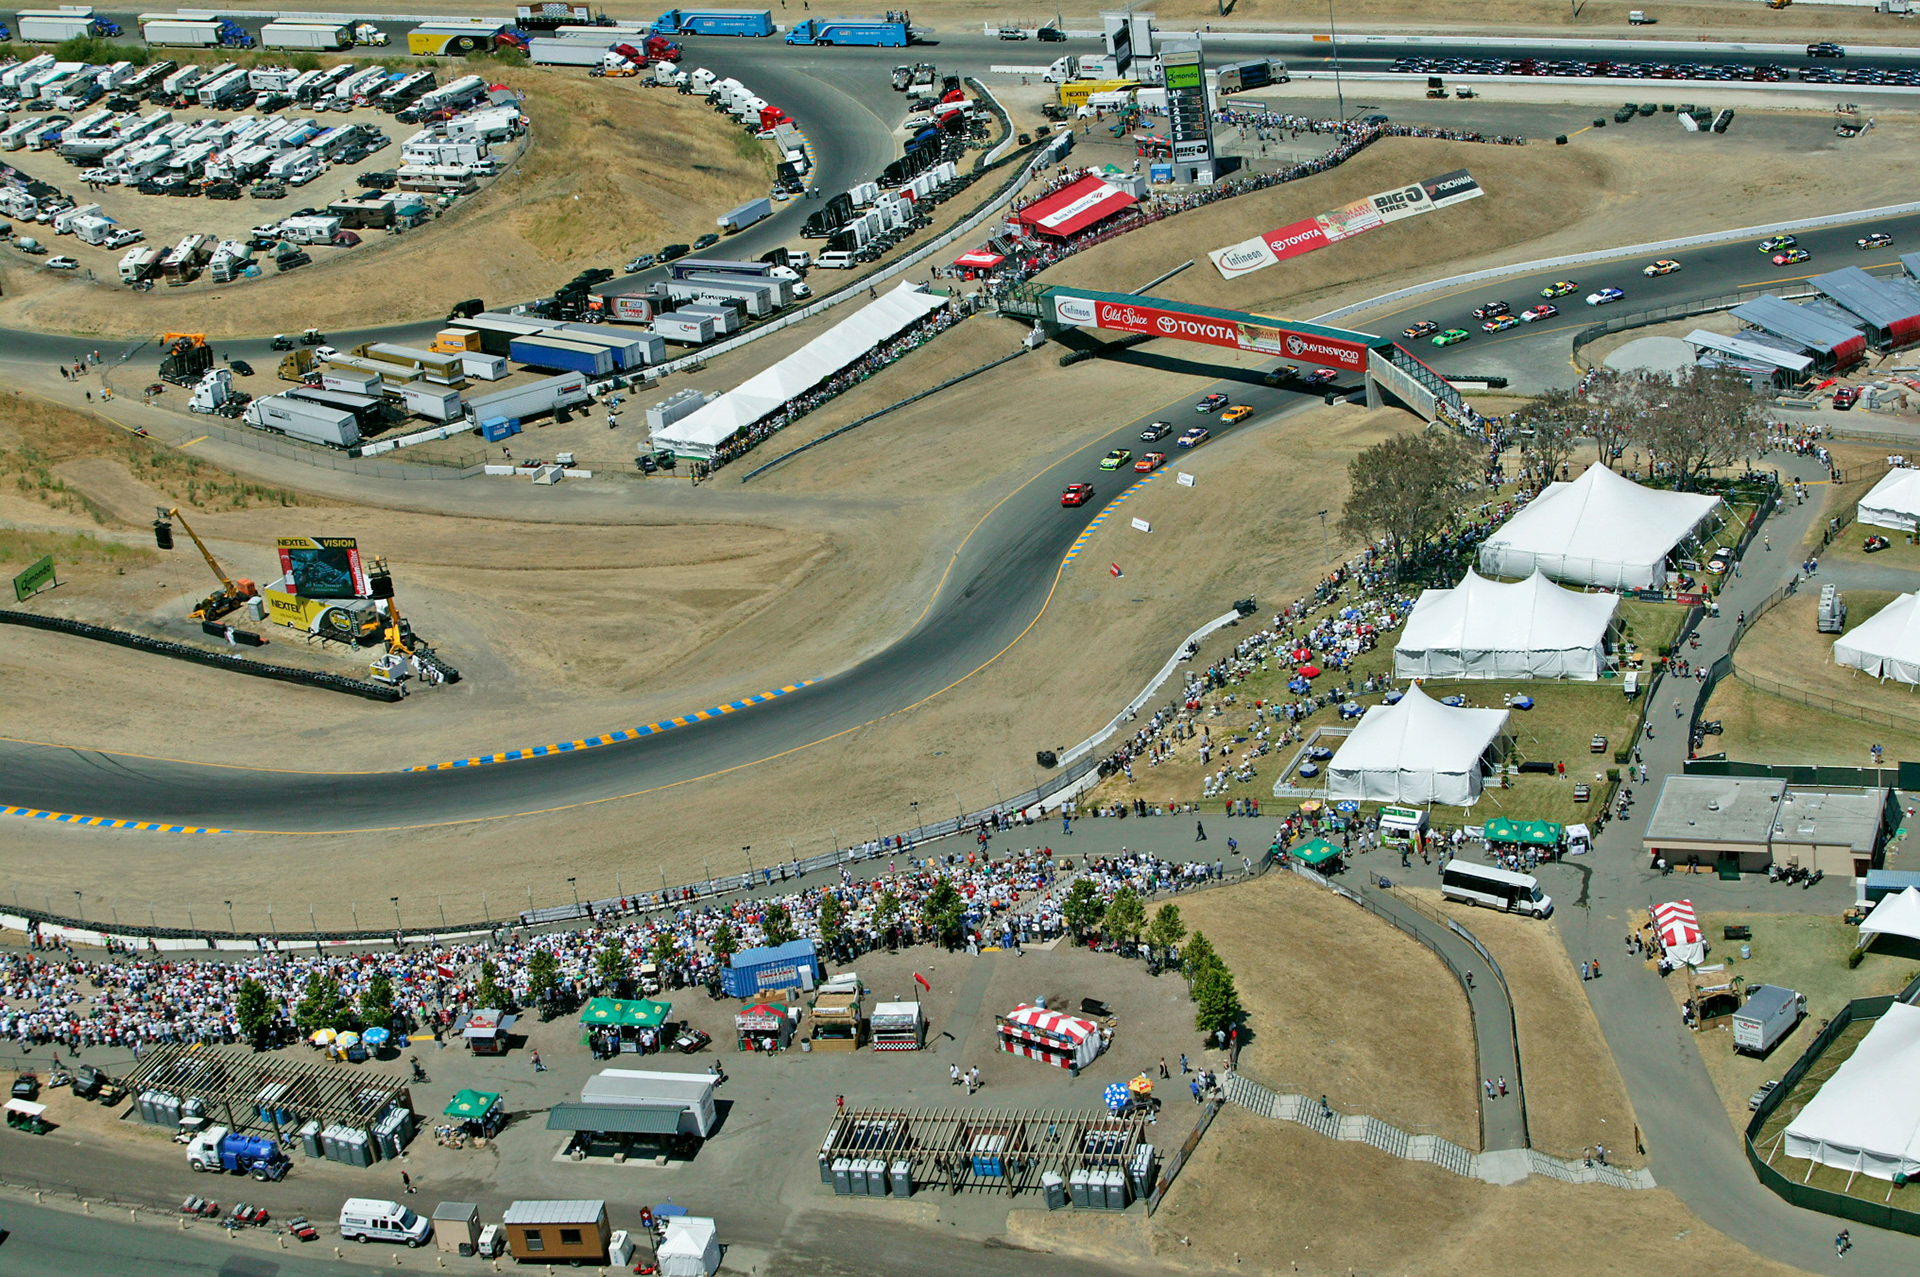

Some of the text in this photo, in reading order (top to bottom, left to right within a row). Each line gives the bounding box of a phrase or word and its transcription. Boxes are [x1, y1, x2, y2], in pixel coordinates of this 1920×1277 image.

[1436, 175, 1474, 191] YOKOHAMA
[1374, 192, 1405, 208] BIG
[1345, 204, 1370, 216] MART
[1379, 202, 1408, 214] TIRES
[1284, 229, 1322, 246] TOYOTA
[1226, 250, 1263, 266] Infineon
[1064, 303, 1091, 317] Infineon
[1102, 305, 1147, 326] Old Spice
[1178, 320, 1235, 340] TOYOTA
[1302, 342, 1359, 360] RAVENSWOOD
[323, 539, 354, 547] VISION
[271, 599, 301, 613] NEXTEL
[1032, 923, 1040, 931] 3
[1743, 1022, 1759, 1030] Ryder
